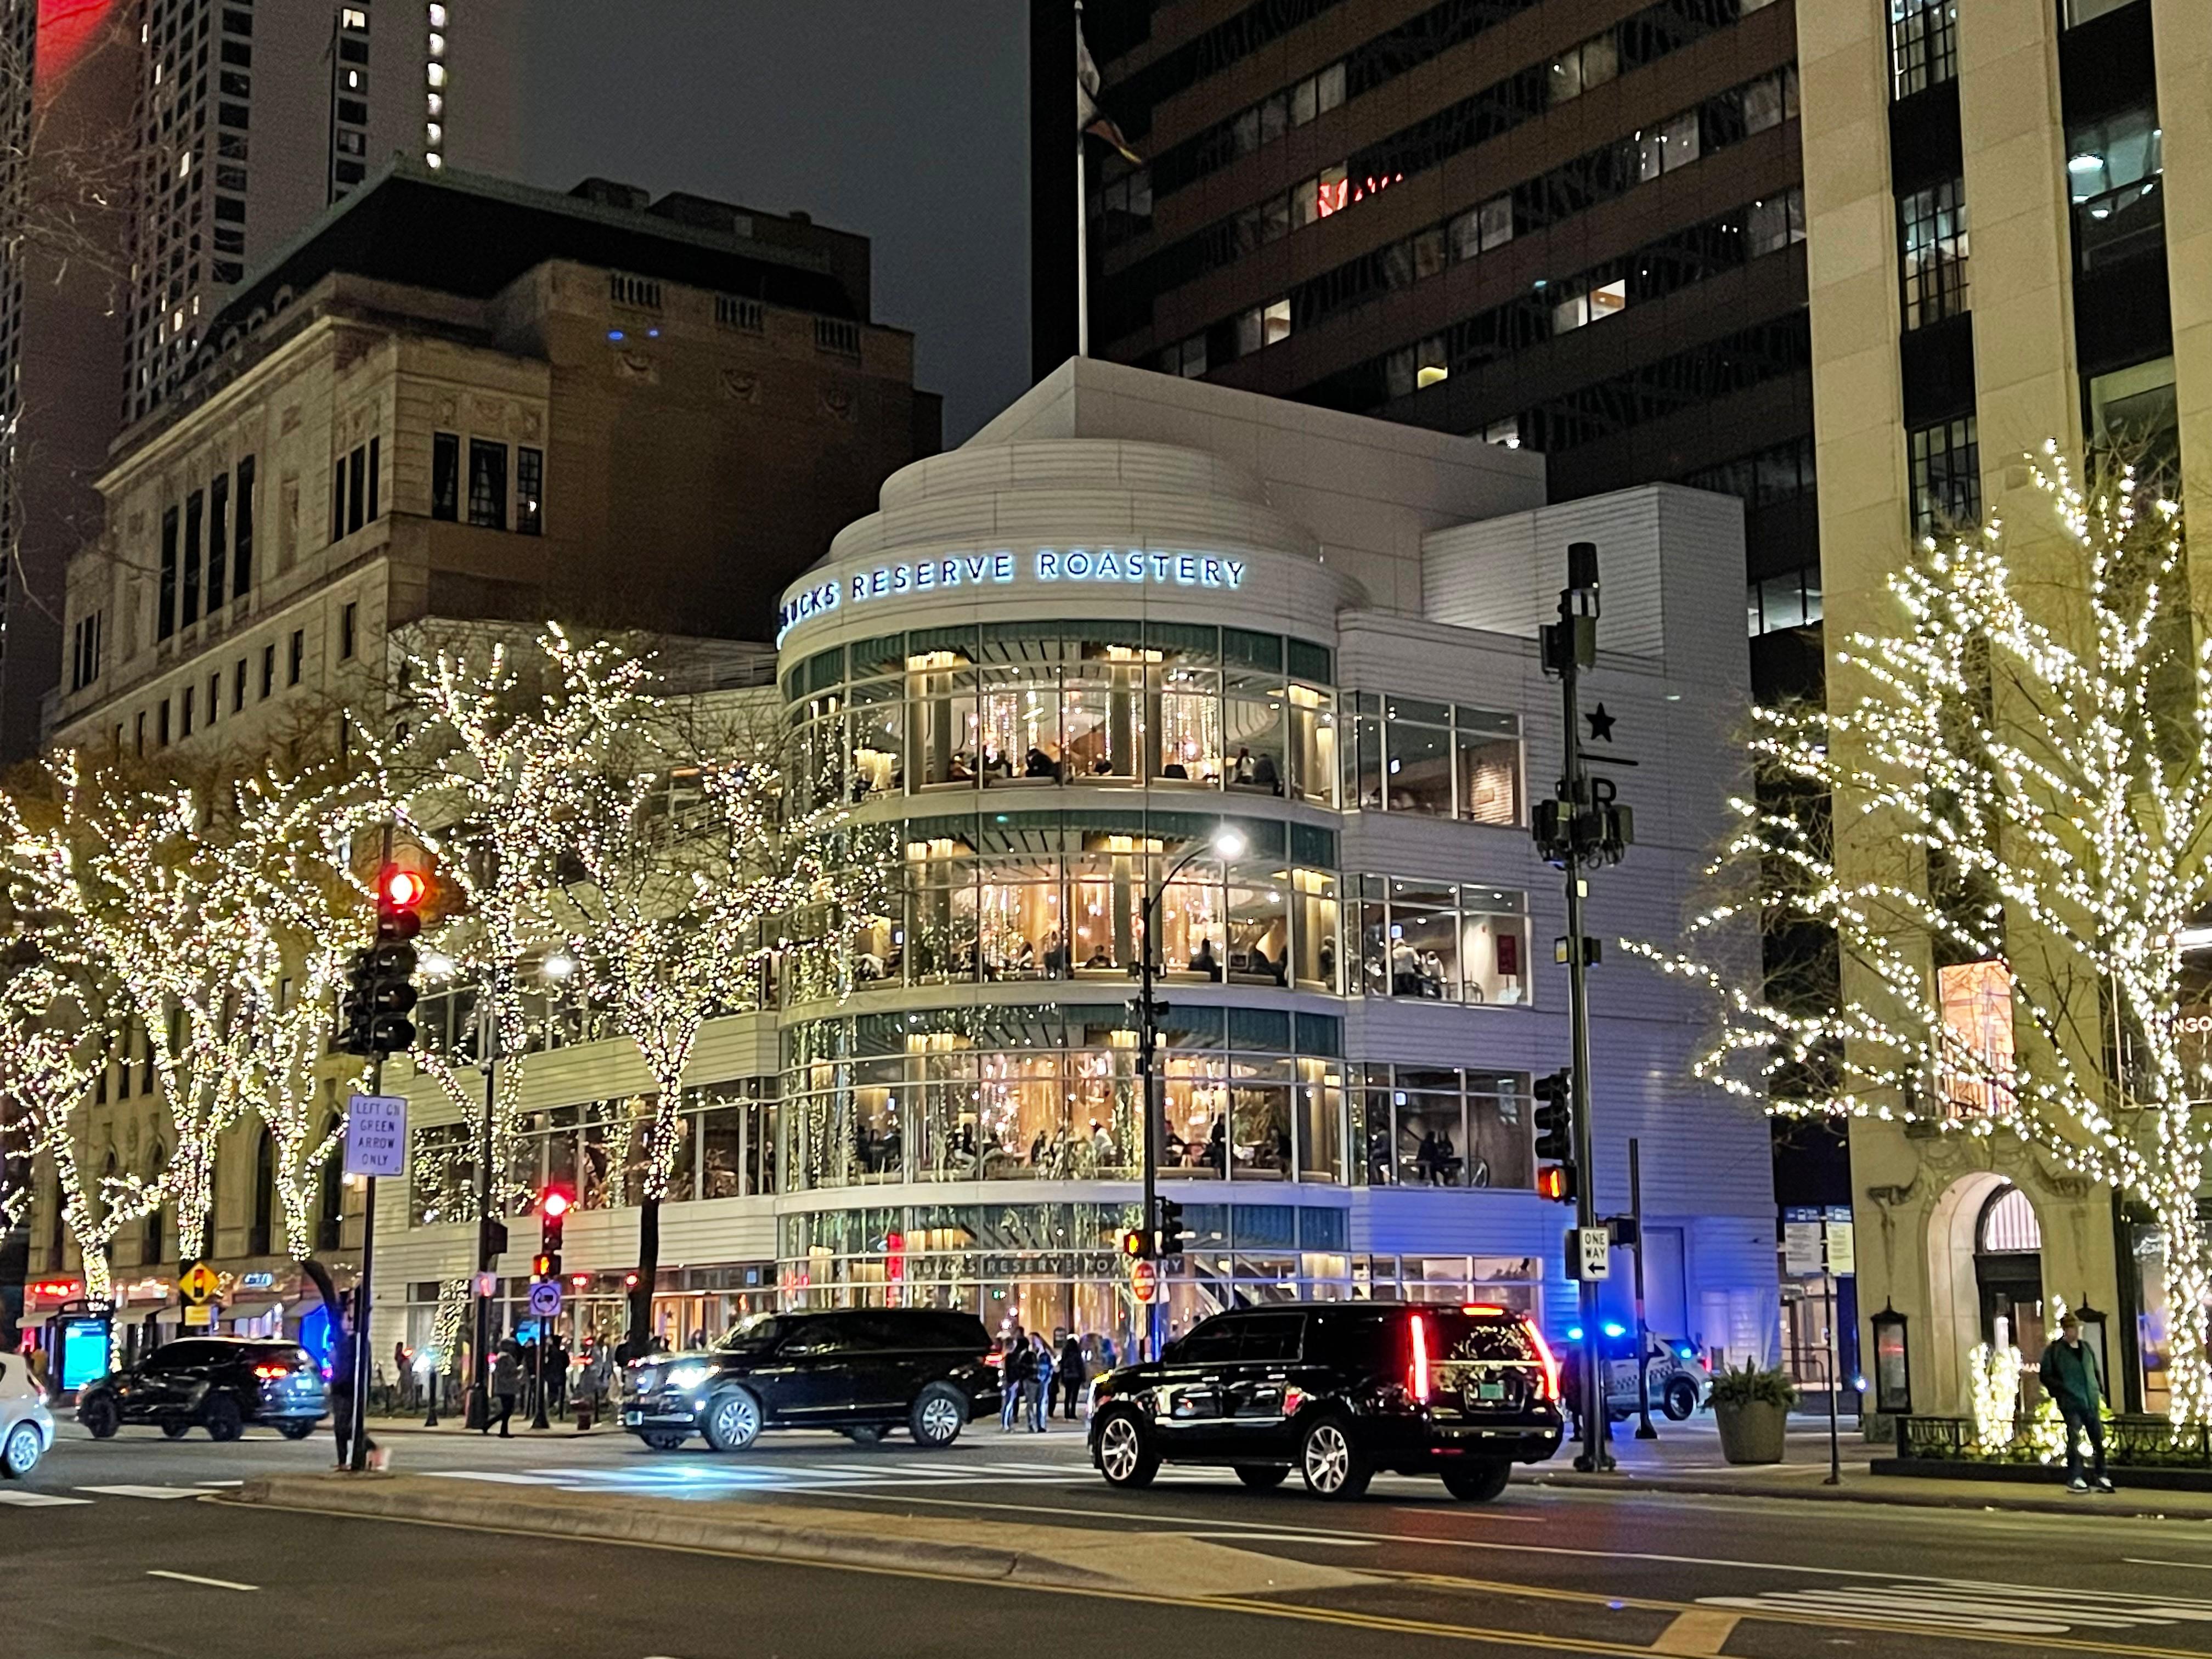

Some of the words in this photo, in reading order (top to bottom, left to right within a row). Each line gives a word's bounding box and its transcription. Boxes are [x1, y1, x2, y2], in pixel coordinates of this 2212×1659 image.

[852, 554, 1013, 601] RESERVE
[1039, 551, 1246, 589] ROASTERY
[357, 1103, 381, 1115] LEFT
[386, 1105, 400, 1116] ON
[360, 1120, 395, 1132] GREEN
[358, 1137, 396, 1149] ARROW
[362, 1154, 388, 1166] ONLY
[1585, 1233, 1605, 1245] ONE
[1585, 1247, 1605, 1259] WAY
